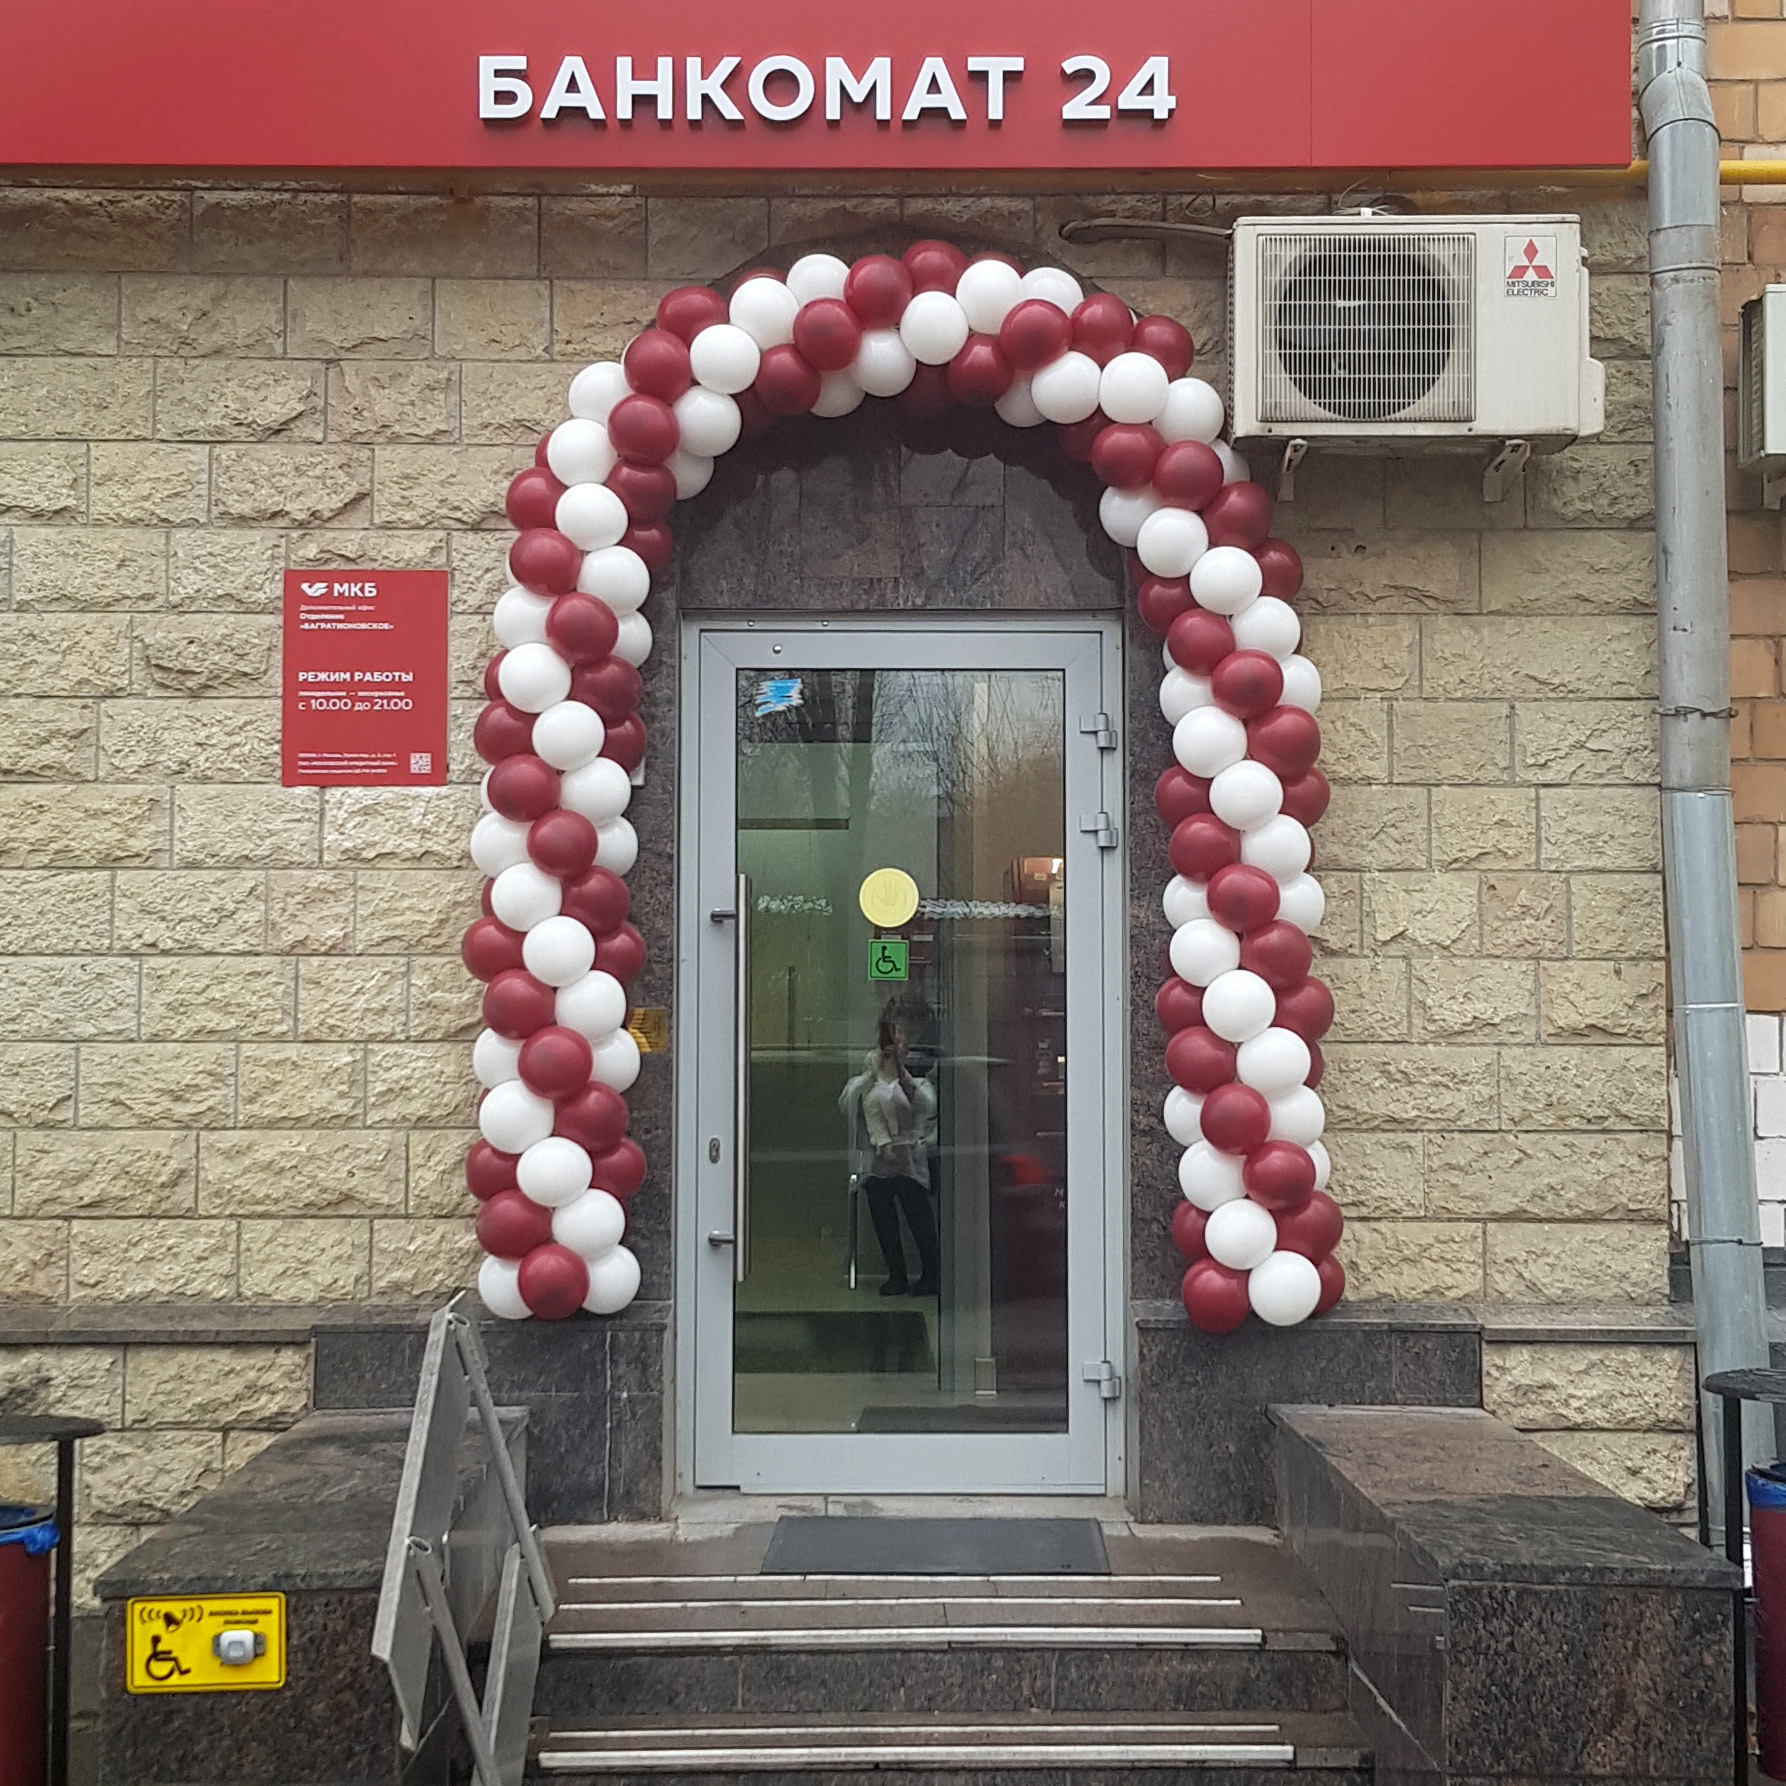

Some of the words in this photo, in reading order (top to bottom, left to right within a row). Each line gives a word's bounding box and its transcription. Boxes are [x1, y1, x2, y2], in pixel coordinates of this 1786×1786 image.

[478, 54, 1025, 122] БАНКОМАТ
[1060, 54, 1178, 121] 24
[1506, 280, 1555, 288] MITSUBISHI
[1506, 288, 1549, 296] ELECTRIC
[333, 582, 378, 598] МКБ
[298, 671, 351, 683] РЕЖИМ
[353, 671, 414, 683] РАБОТЫ
[298, 702, 307, 710] с
[310, 698, 352, 711] 10.00
[354, 701, 372, 712] до
[373, 698, 413, 711] 21.00
